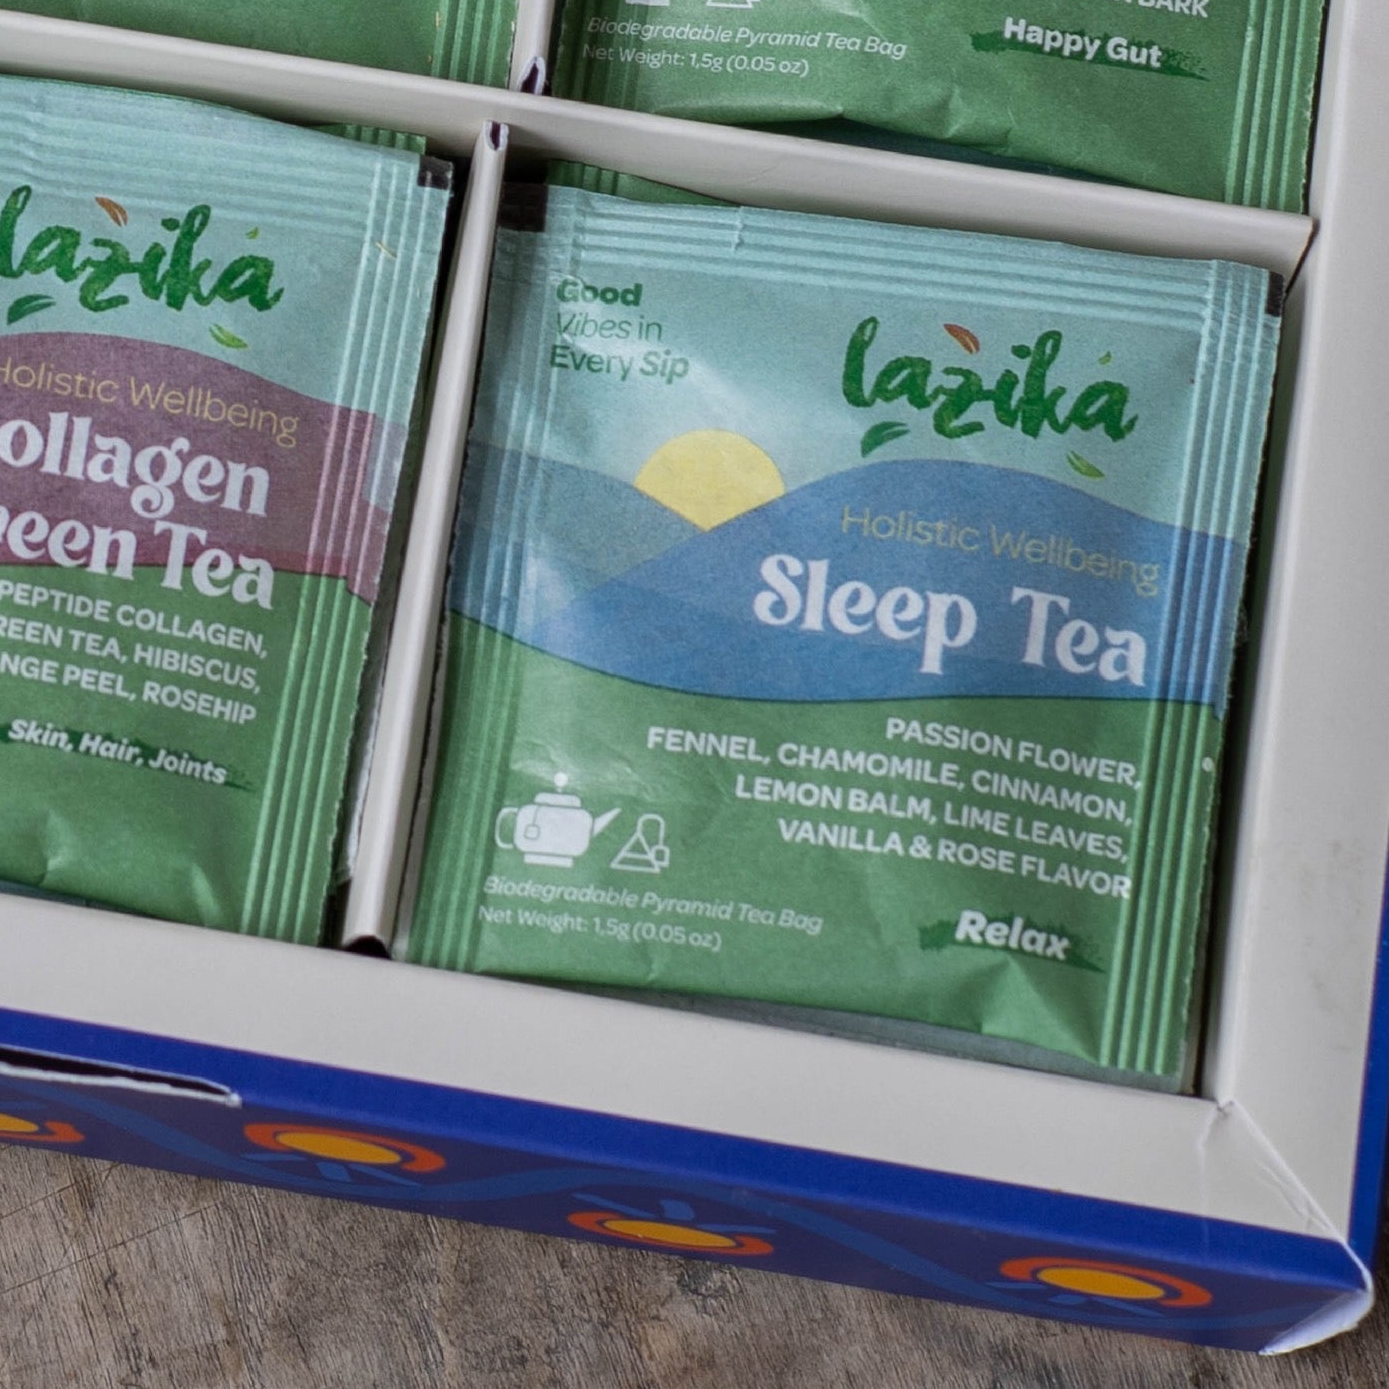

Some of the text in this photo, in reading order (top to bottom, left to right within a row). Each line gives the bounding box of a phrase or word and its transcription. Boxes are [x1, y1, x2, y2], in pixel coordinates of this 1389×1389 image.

[1004, 17, 1162, 67] Happy Gut
[155, 520, 274, 609] Tea
[753, 555, 1146, 686] Sleep Tea
[9, 719, 227, 784] Skin, Hair, Joints
[956, 910, 1069, 960] Relax
